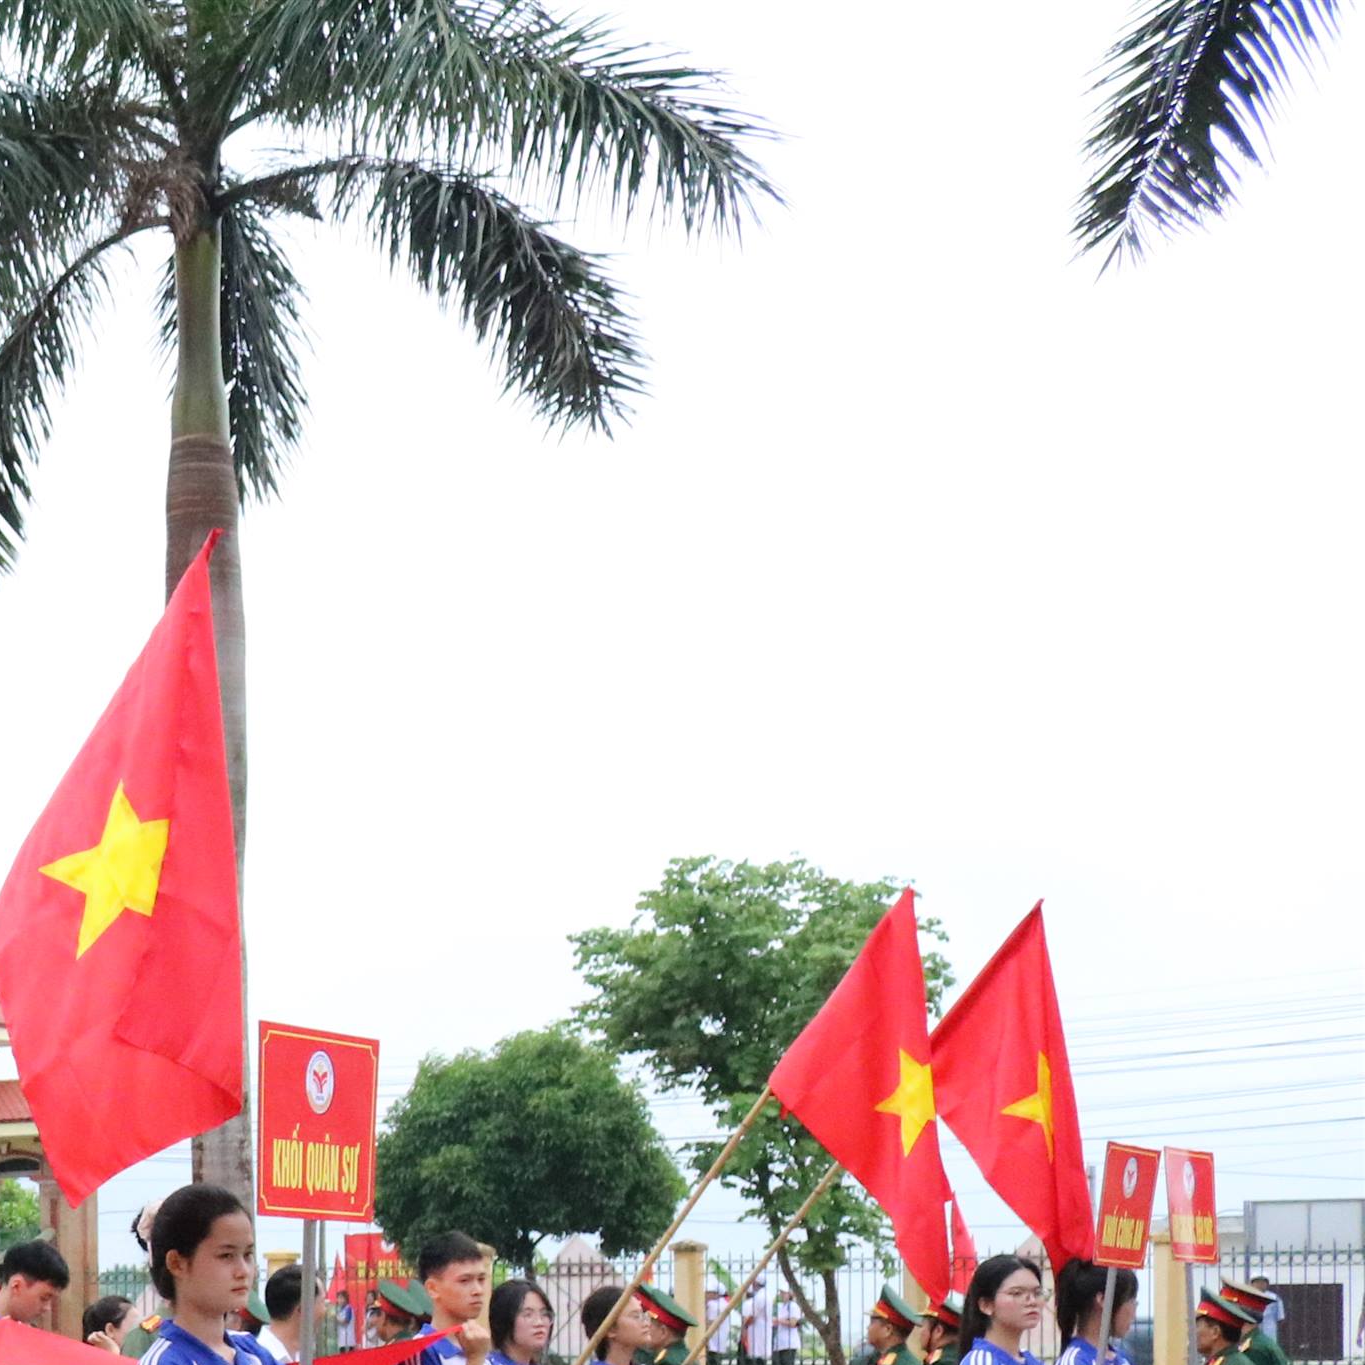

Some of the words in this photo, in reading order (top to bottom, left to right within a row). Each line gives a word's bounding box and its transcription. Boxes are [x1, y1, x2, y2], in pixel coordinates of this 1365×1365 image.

[272, 1122, 303, 1189] KHỐI
[306, 1133, 339, 1196] QUÂN
[341, 1142, 361, 1205] SỰ
